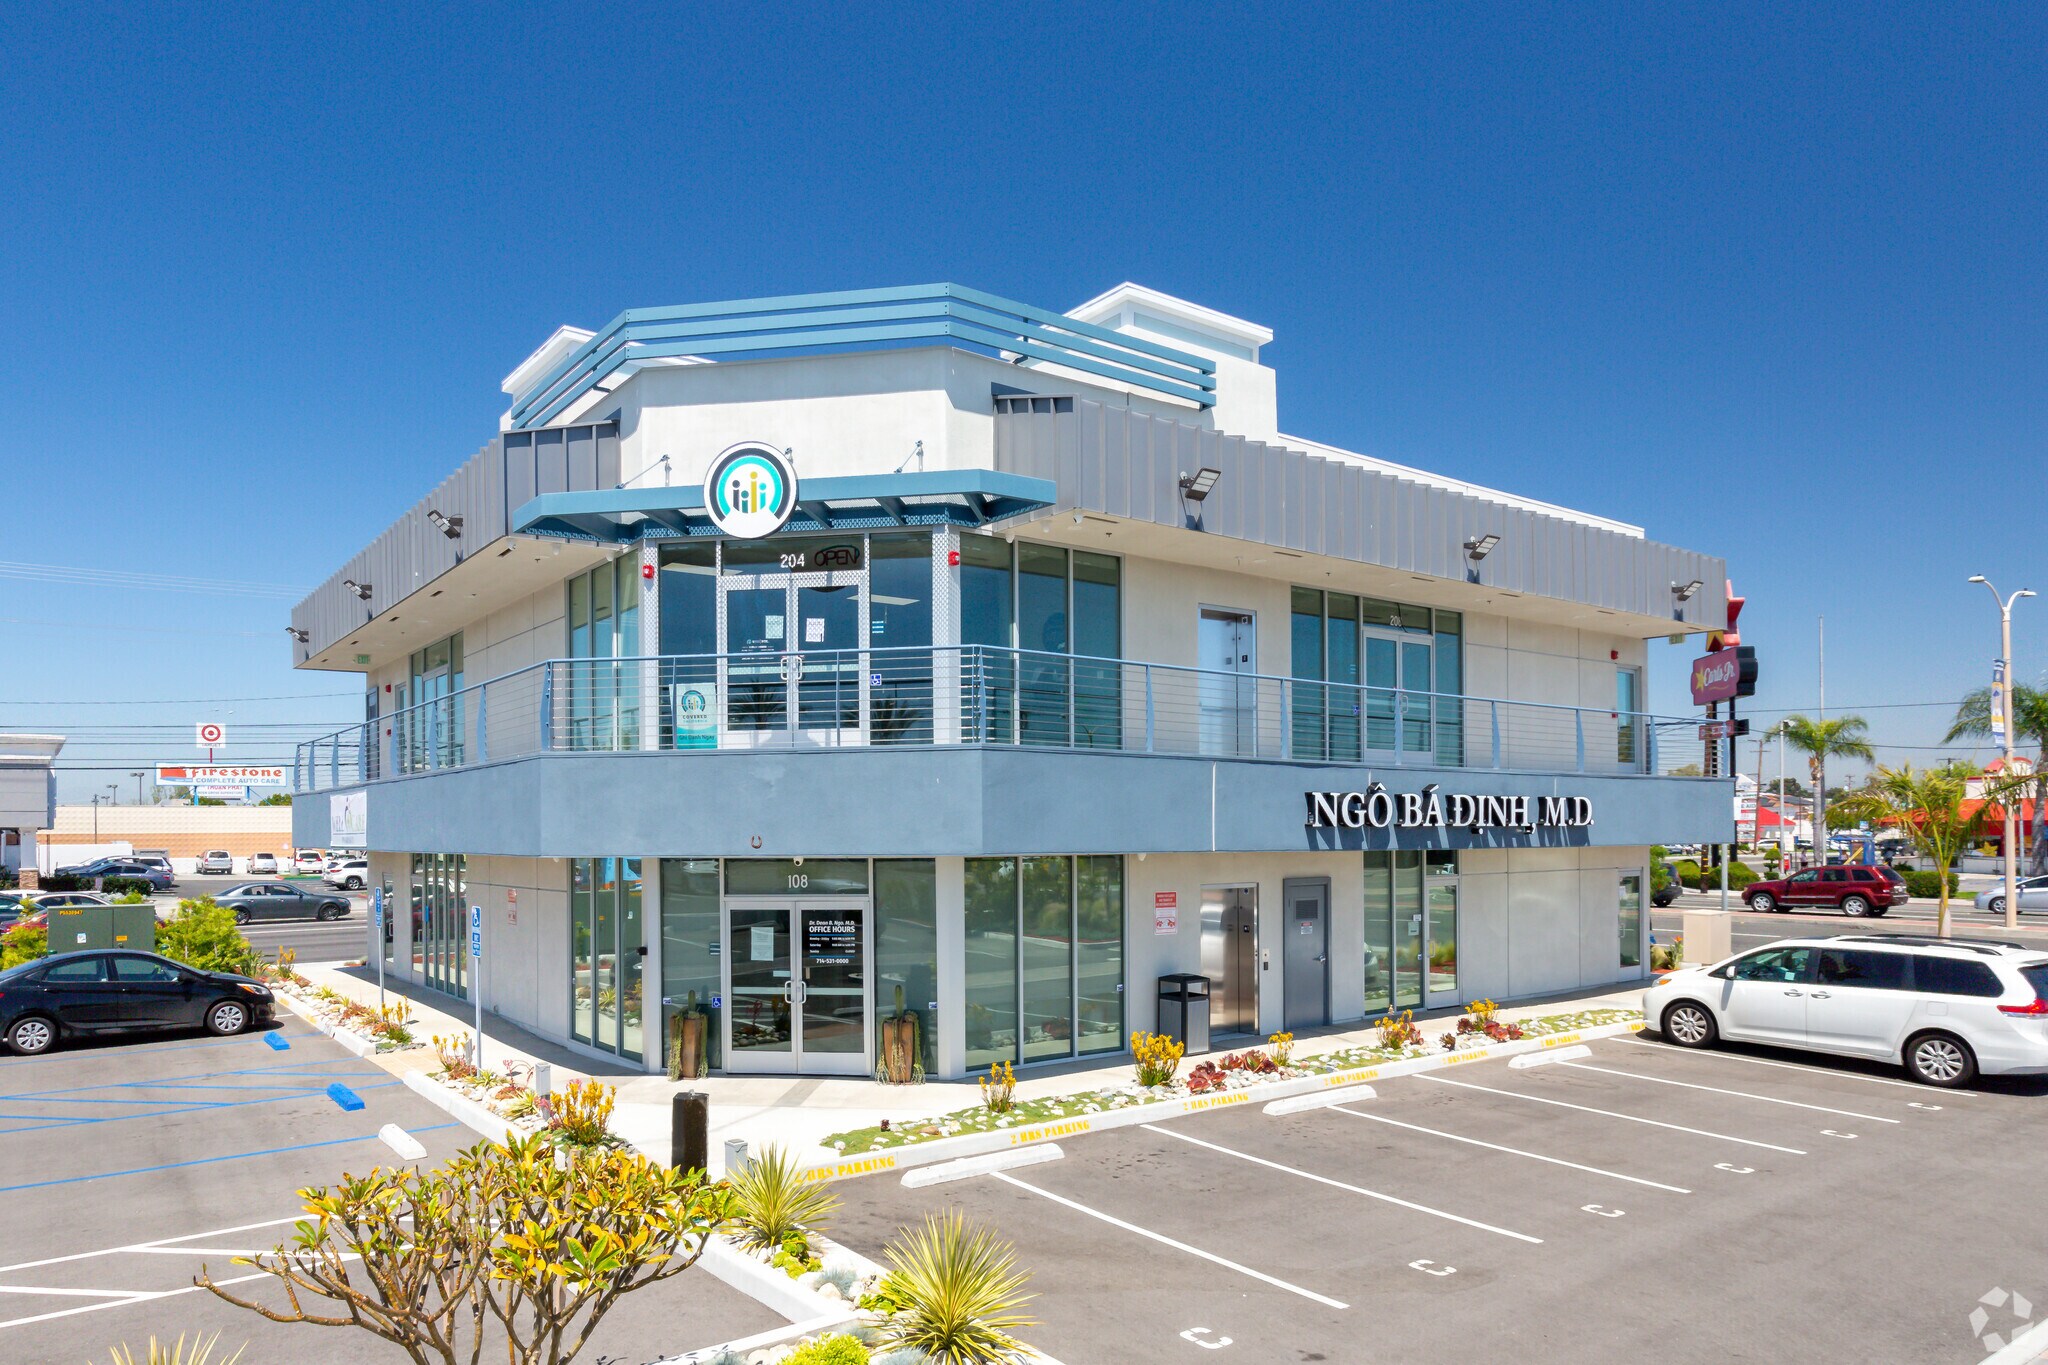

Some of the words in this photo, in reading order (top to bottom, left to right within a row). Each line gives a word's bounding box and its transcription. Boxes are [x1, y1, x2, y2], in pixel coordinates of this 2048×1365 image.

[780, 553, 805, 568] 204
[814, 547, 858, 567] OPEN
[192, 767, 282, 778] Firestone
[1312, 782, 1393, 827] NGÔ
[1401, 784, 1446, 827] BÁ
[1544, 796, 1595, 826] M.D.
[788, 874, 808, 888] 108
[1183, 1102, 1189, 1111] 2
[1191, 1099, 1209, 1110] HRS
[1211, 1091, 1249, 1107] PARKING
[1010, 1134, 1017, 1144] 2
[1020, 1129, 1042, 1143] HRS
[1044, 1119, 1091, 1137] PARKING
[807, 1166, 835, 1181] HRS
[838, 1155, 896, 1177] PARKING
